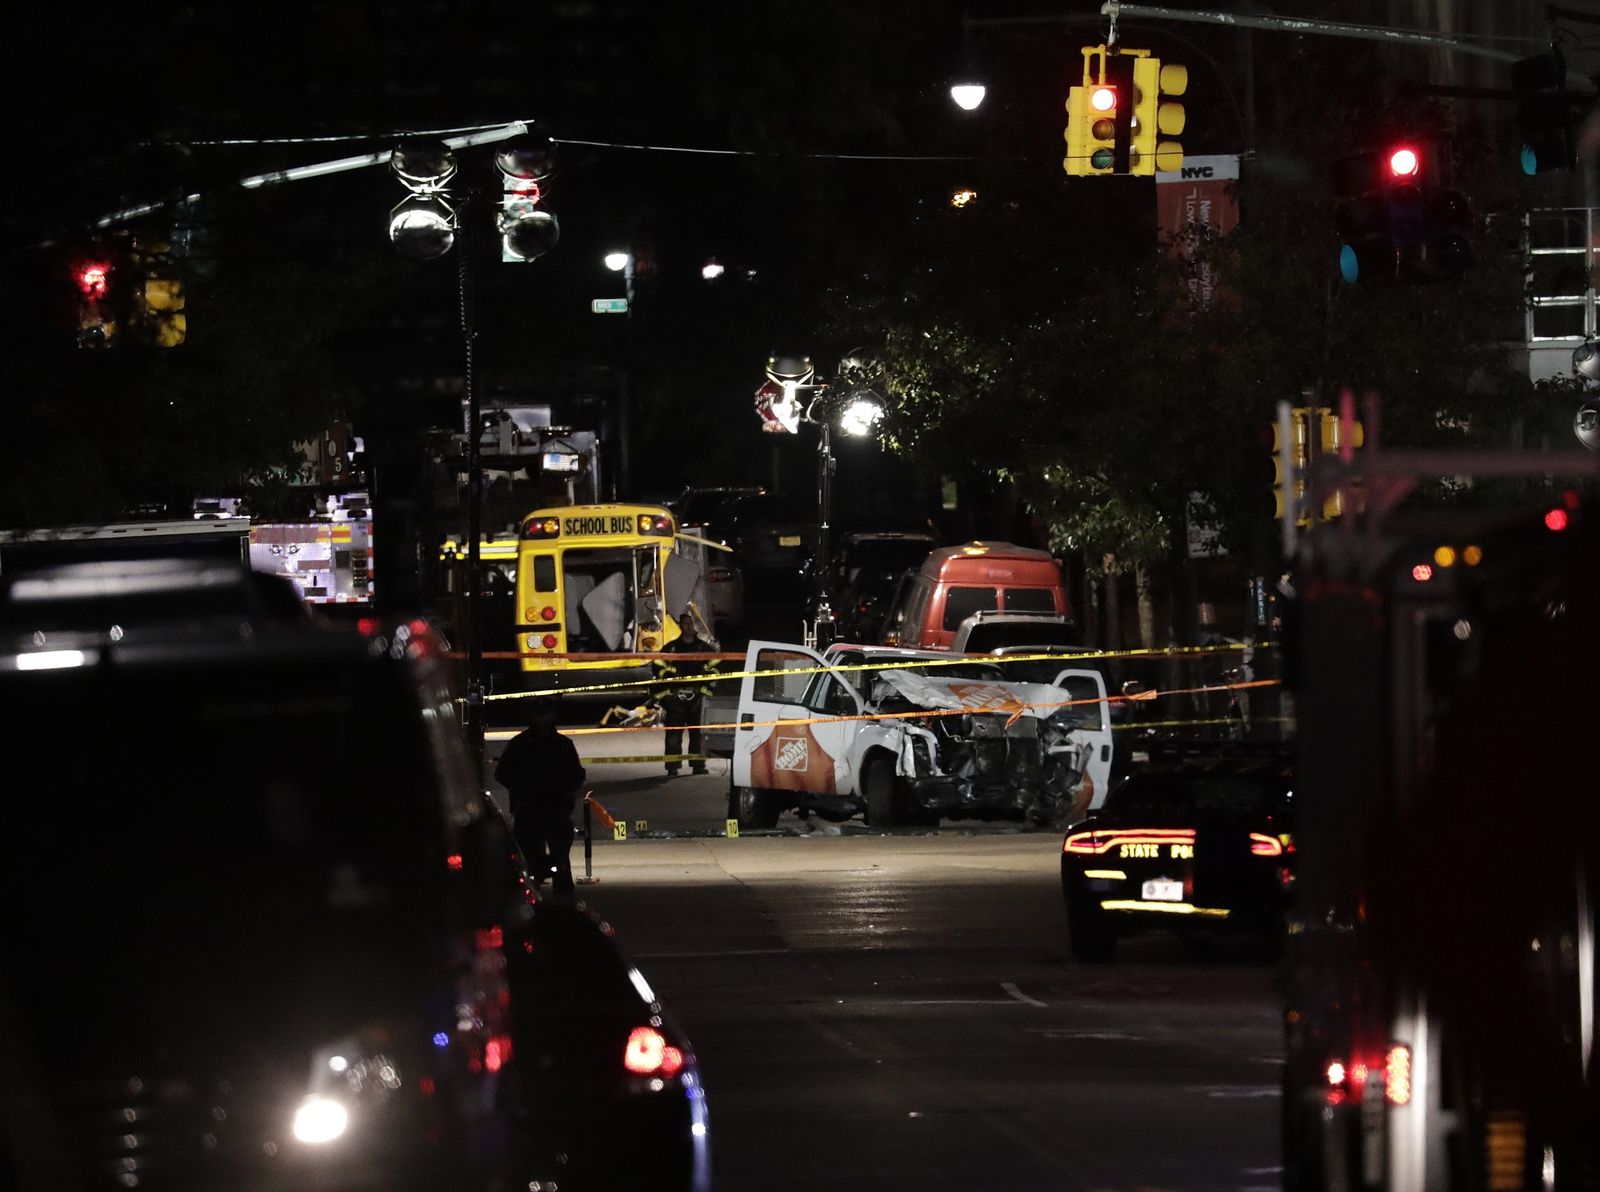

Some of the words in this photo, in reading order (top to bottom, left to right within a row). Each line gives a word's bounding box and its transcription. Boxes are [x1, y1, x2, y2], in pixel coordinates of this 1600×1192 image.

[1181, 166, 1214, 180] NYC
[565, 516, 609, 535] SCHOOL
[610, 516, 633, 533] BUS
[777, 740, 806, 768] HOME
[616, 823, 626, 837] 12
[728, 822, 737, 835] 10
[1120, 844, 1159, 858] STATE
